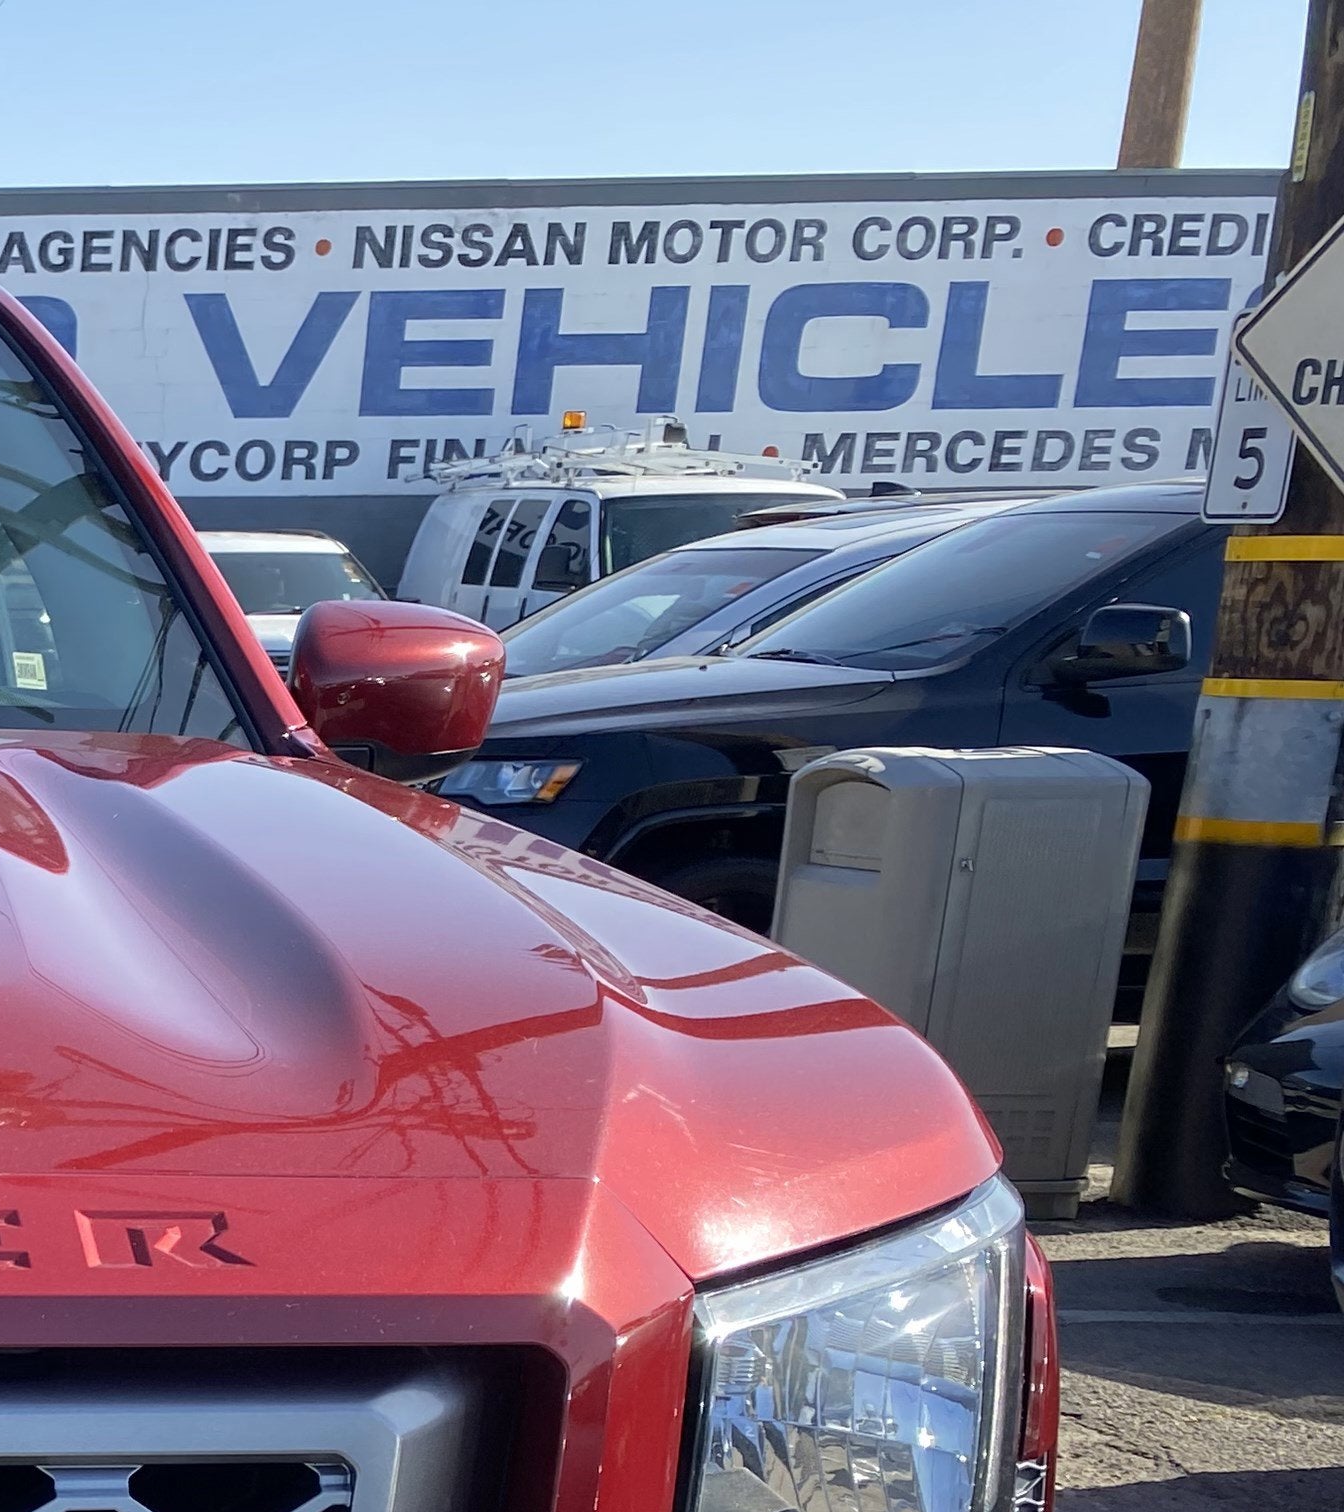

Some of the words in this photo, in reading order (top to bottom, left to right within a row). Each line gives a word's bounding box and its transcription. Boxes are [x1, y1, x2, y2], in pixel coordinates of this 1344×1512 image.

[352, 221, 587, 269] NISSAN
[608, 217, 828, 265] MOTOR
[852, 214, 1024, 260] CORP.
[1088, 212, 1270, 258] CREDI
[183, 277, 1265, 420] VEHICLE
[134, 438, 361, 483] YCORP
[800, 427, 1162, 474] MERCEDES
[1233, 427, 1268, 490] 5
